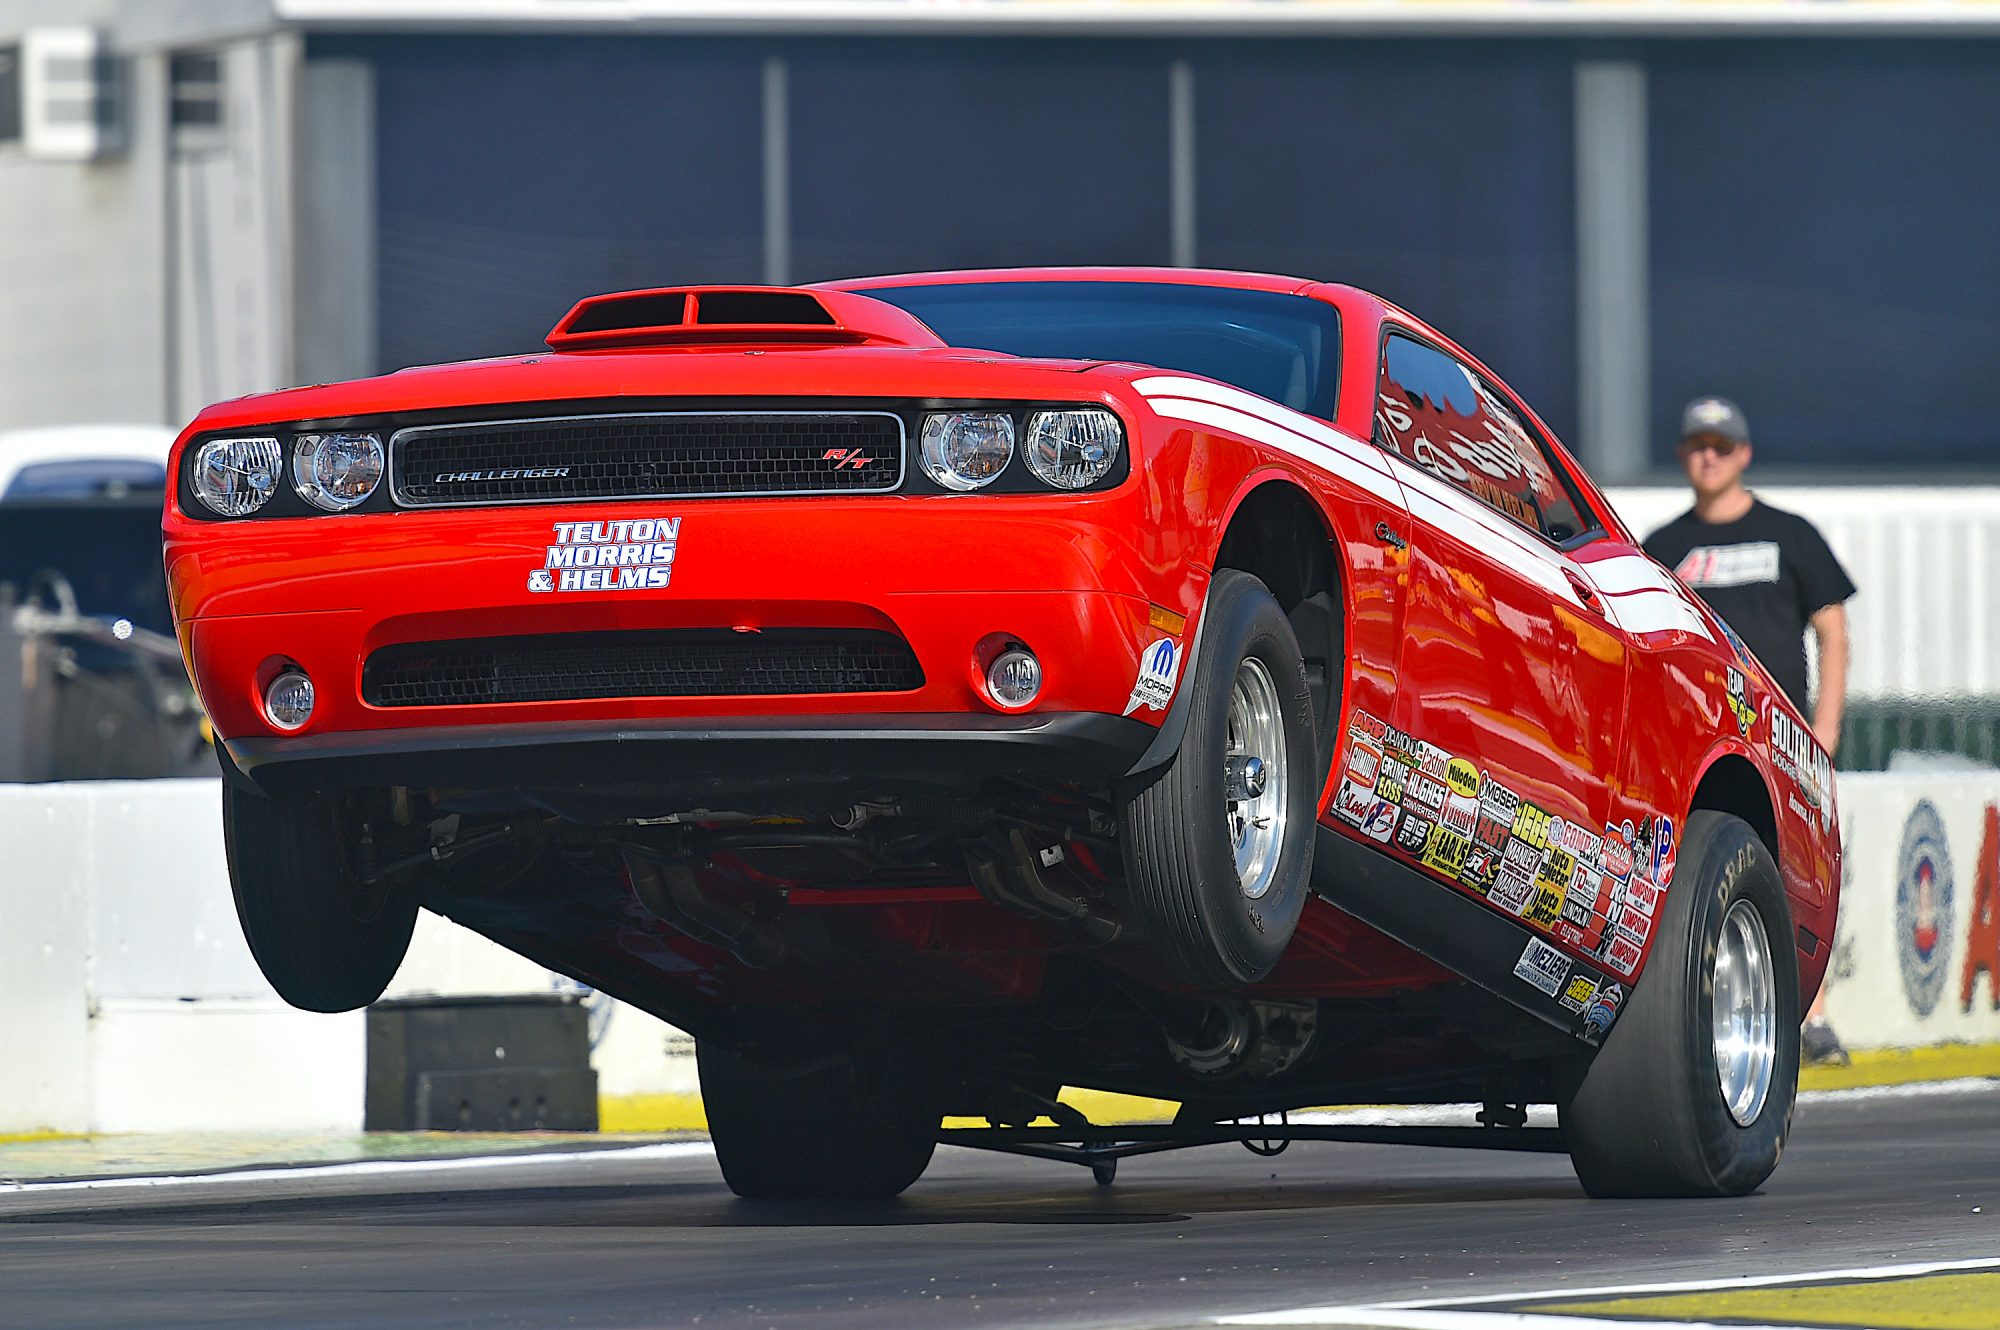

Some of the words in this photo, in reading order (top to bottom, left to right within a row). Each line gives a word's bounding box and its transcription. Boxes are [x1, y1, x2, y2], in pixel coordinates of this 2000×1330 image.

[822, 448, 874, 470] R/T
[435, 467, 569, 484] CHALLENGER
[553, 517, 682, 545] TEUTON
[545, 543, 677, 569] MORRIS
[527, 569, 555, 593] &
[558, 565, 672, 592] HELMS
[1138, 675, 1171, 697] MOPAR
[1727, 666, 1745, 694] TEAM
[1351, 712, 1386, 741] ARP
[1384, 725, 1418, 757] DIAMOND
[1772, 705, 1831, 790] SOUTHLAND
[1349, 746, 1379, 780] GUMOUT
[1381, 755, 1410, 784] GRIME
[1421, 747, 1449, 780] Castrol
[1772, 750, 1797, 780] DODGE
[1407, 772, 1446, 809] HUGHES
[1447, 764, 1477, 792] Milodon
[1402, 797, 1440, 820] CONVERTERS
[1487, 780, 1518, 812] MOSER
[1398, 829, 1423, 850] STUFF
[1403, 814, 1428, 838] BIG
[1476, 816, 1508, 850] FAST
[1563, 824, 1591, 853] COMP
[1435, 831, 1470, 867] EARL'S
[1551, 848, 1570, 871] Auto
[1603, 836, 1623, 859] LUCAS
[1620, 846, 1632, 865] OIL
[1546, 863, 1569, 888] Meter
[1540, 888, 1559, 909] Auto
[1630, 878, 1657, 906] SIMPSON
[1533, 902, 1558, 926] Meter
[1621, 908, 1649, 936] SIMPSON
[1531, 941, 1569, 981] MEZIERE
[1610, 938, 1639, 967] SIMPSON
[1567, 978, 1595, 1003] JEGS
